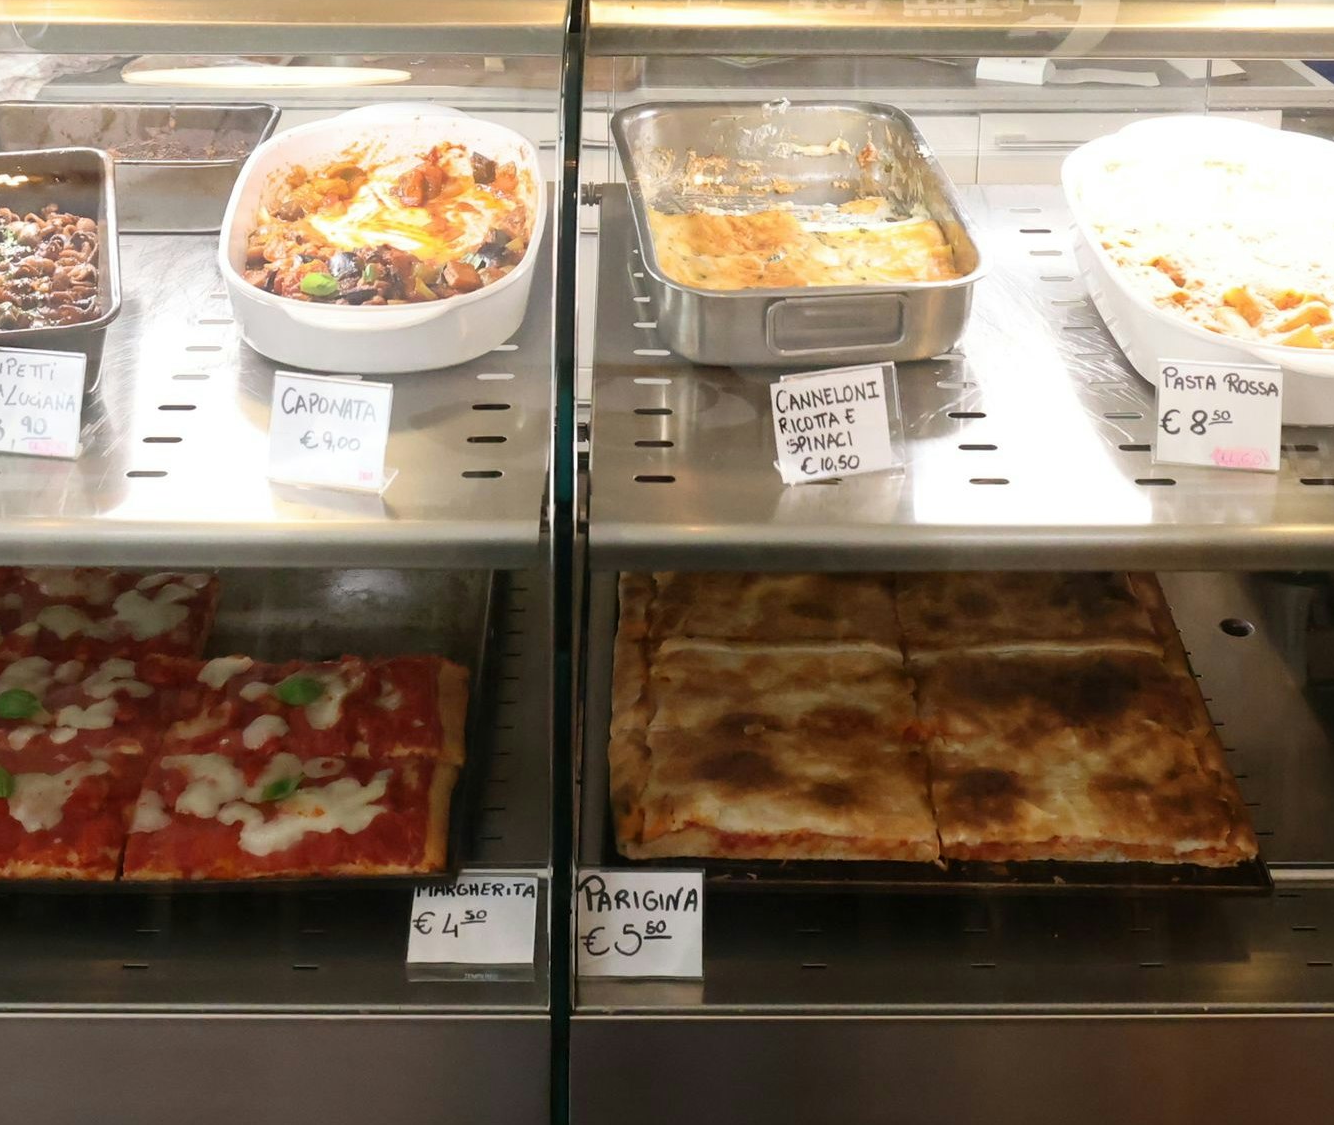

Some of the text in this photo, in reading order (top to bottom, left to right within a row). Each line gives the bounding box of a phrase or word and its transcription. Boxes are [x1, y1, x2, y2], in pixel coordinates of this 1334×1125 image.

[775, 380, 880, 414] CANNELONI
[1162, 366, 1280, 398] PASTA ROSSA
[281, 386, 377, 423] CAPONATA
[778, 408, 855, 435] RICOTTA E
[786, 430, 854, 455] SPINACI
[417, 883, 536, 898] MARGHERITA
[577, 875, 699, 913] PARIGINA
